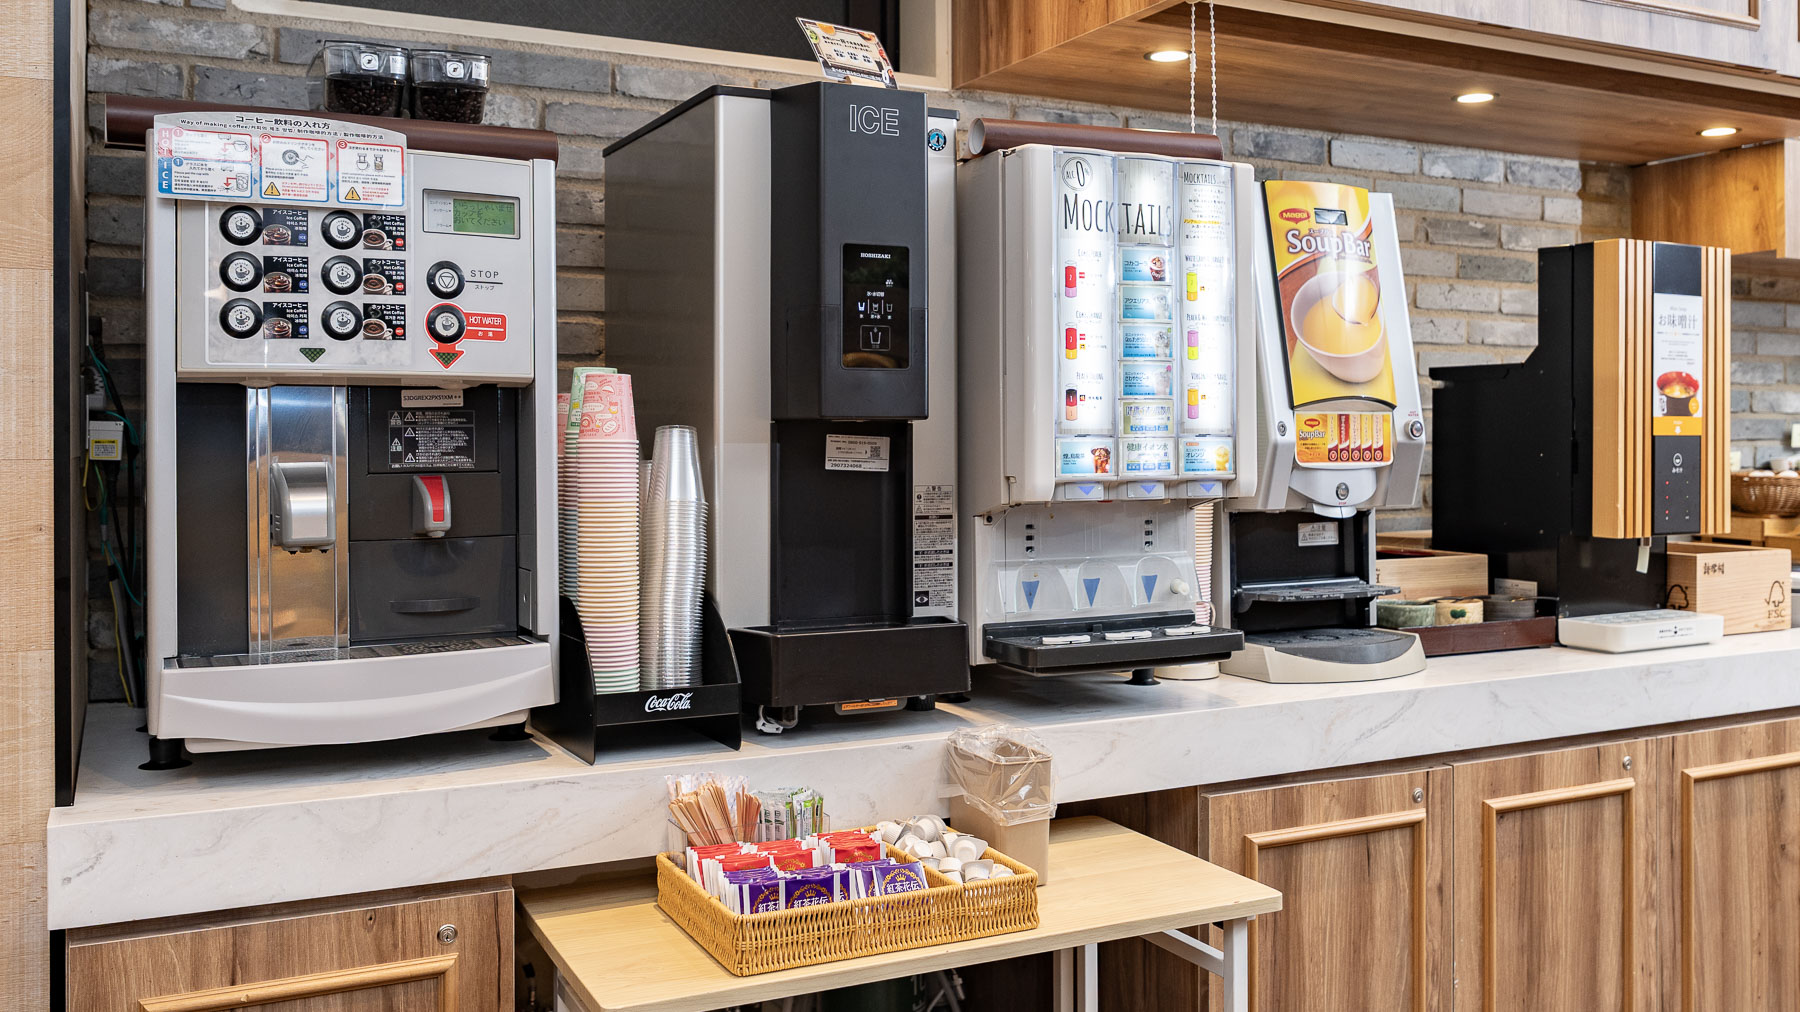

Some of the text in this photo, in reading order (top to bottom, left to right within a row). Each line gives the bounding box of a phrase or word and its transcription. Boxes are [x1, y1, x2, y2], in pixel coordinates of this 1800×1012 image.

[236, 115, 330, 130] コーヒー飲料の入れ方
[850, 104, 900, 136] ICE
[454, 202, 512, 213] いらっしゃいませ
[454, 218, 506, 226] おいてください
[470, 269, 499, 278] STOP
[482, 316, 502, 325] WATER
[1658, 313, 1697, 329] お味噌汁
[1768, 609, 1786, 618] FSC
[645, 692, 693, 712] Coca-Cola
[887, 881, 920, 893] 紅茶花伝
[794, 896, 828, 908] 紅茶花伝
